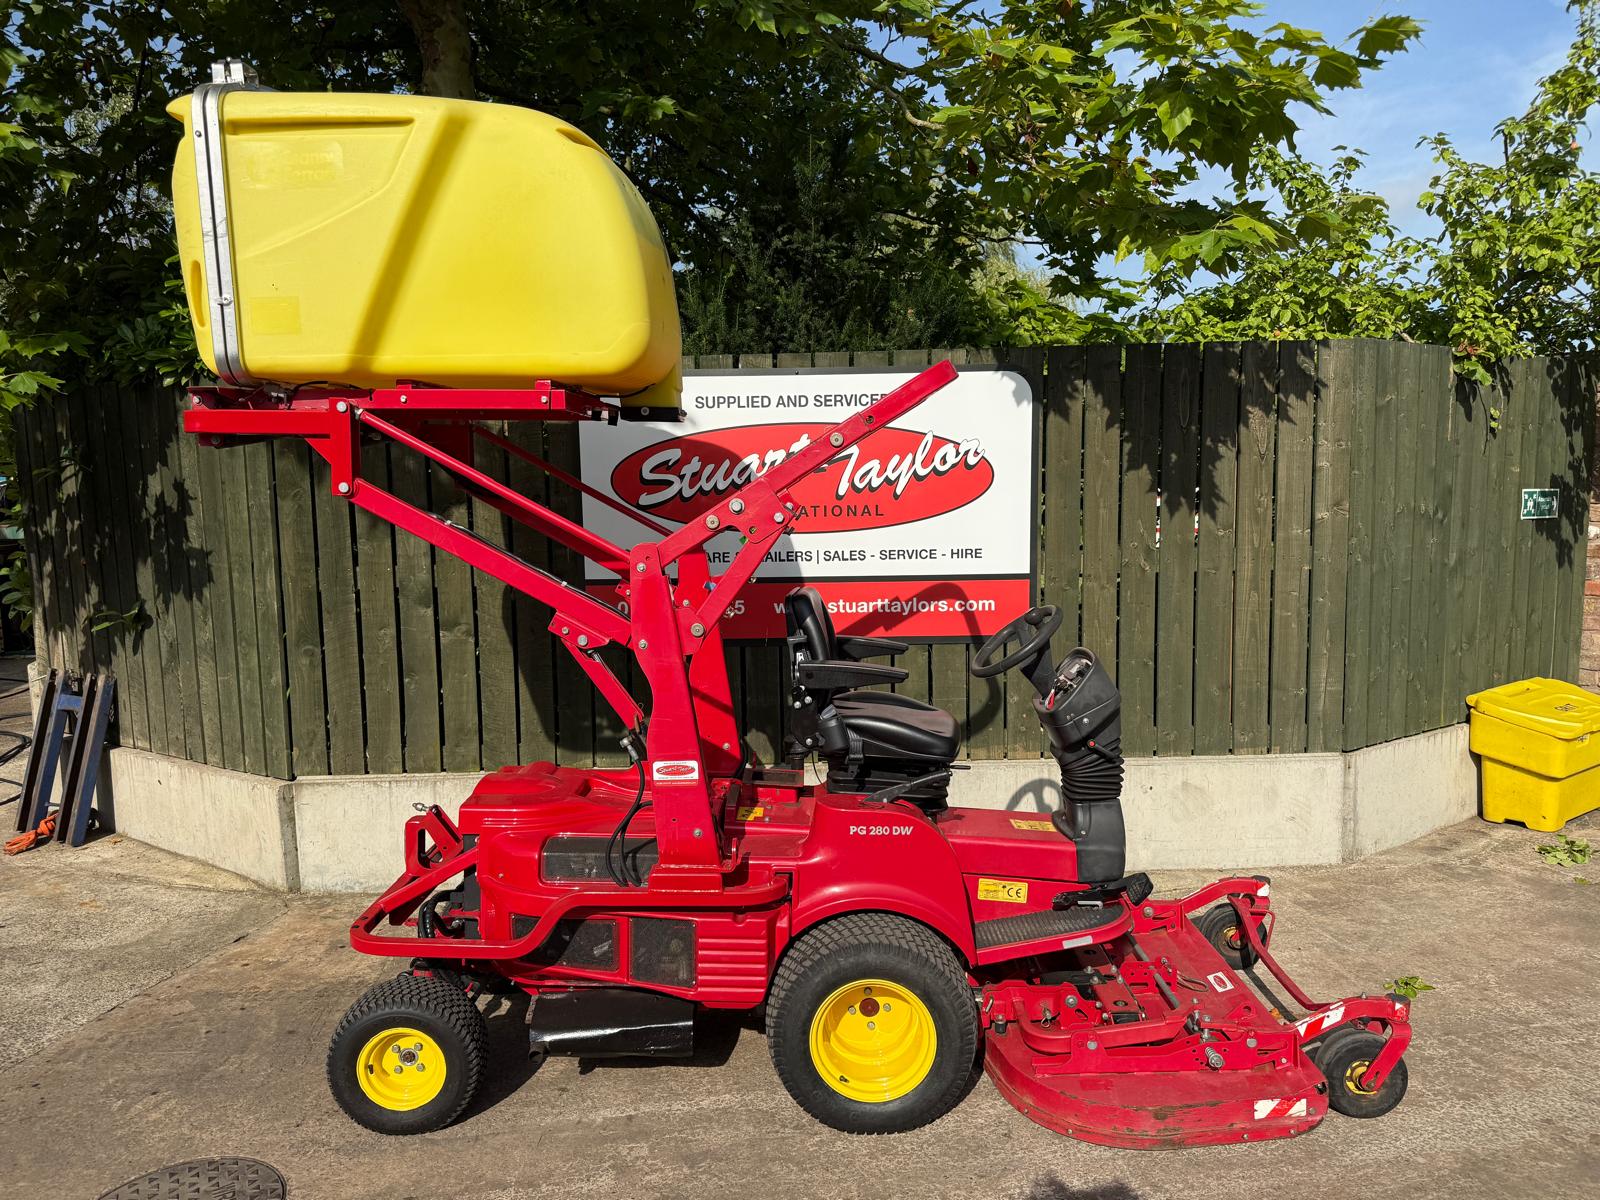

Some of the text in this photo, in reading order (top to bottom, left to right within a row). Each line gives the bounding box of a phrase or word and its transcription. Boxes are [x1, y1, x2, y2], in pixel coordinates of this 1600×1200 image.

[695, 393, 888, 409] SUPPLIED AND SERVICE
[814, 430, 986, 500] Taylor
[799, 504, 884, 518] ATIONAL
[761, 550, 813, 563] AILERS
[823, 550, 867, 562] SALES
[879, 548, 938, 561] SERVICE
[950, 548, 983, 559] HIRE
[849, 825, 914, 836] PG 280 DW
